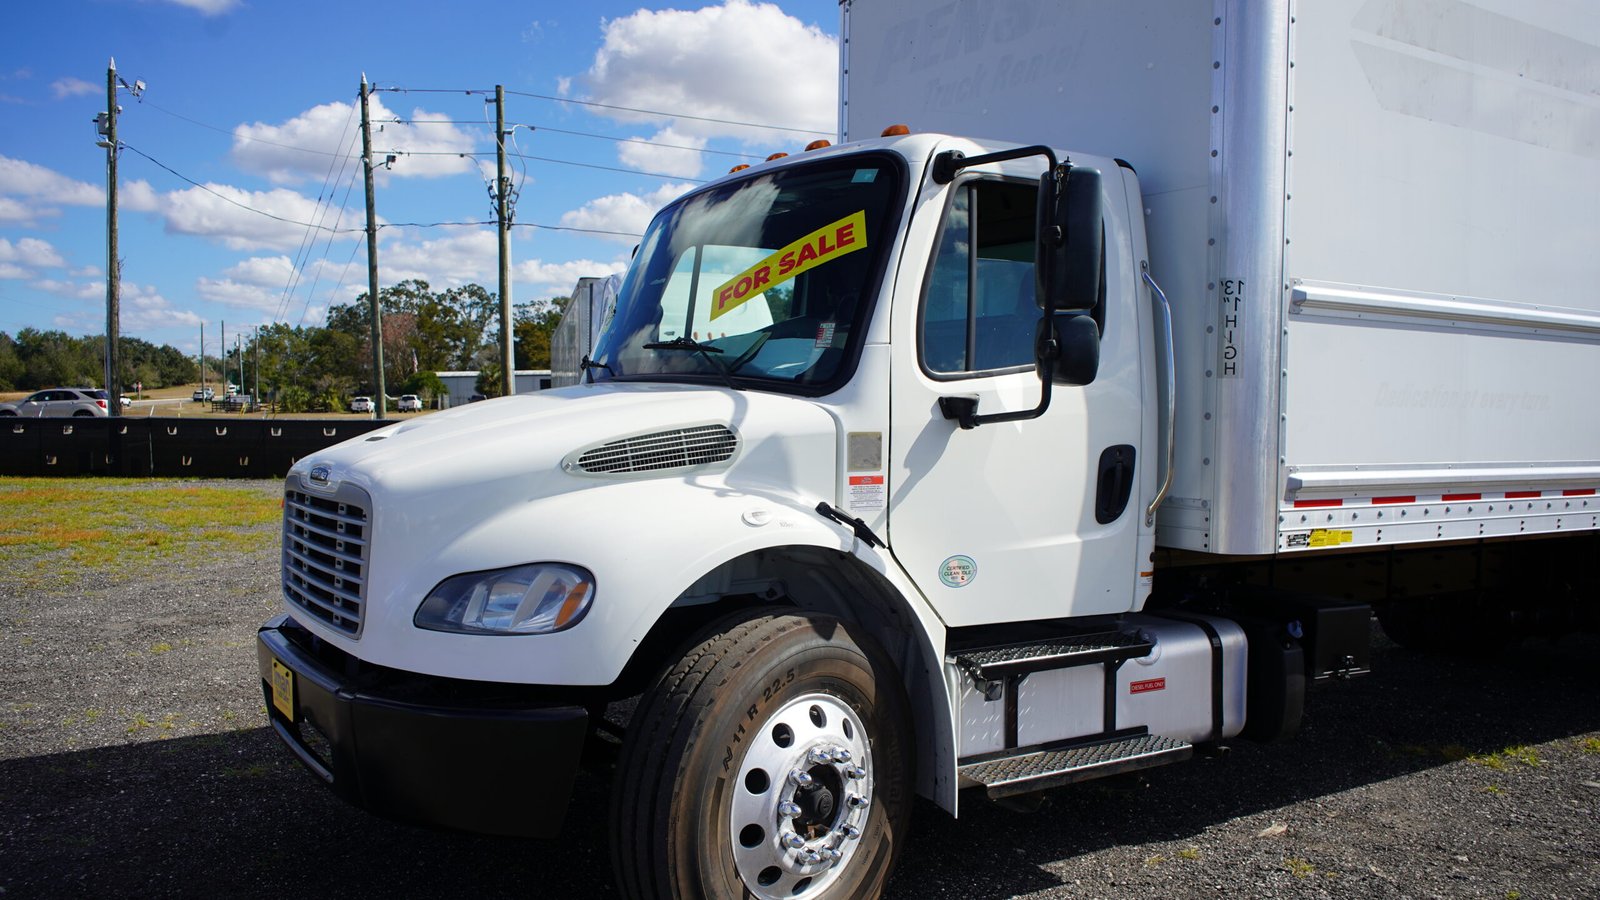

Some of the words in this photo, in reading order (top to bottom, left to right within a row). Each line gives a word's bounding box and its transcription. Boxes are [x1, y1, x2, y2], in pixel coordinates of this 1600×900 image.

[921, 63, 986, 111] Truck
[991, 29, 1089, 94] Rental
[718, 265, 771, 310] FOR
[779, 223, 855, 275] SALE
[733, 723, 746, 743] 11
[747, 703, 759, 720] R
[763, 668, 795, 703] 22.5
